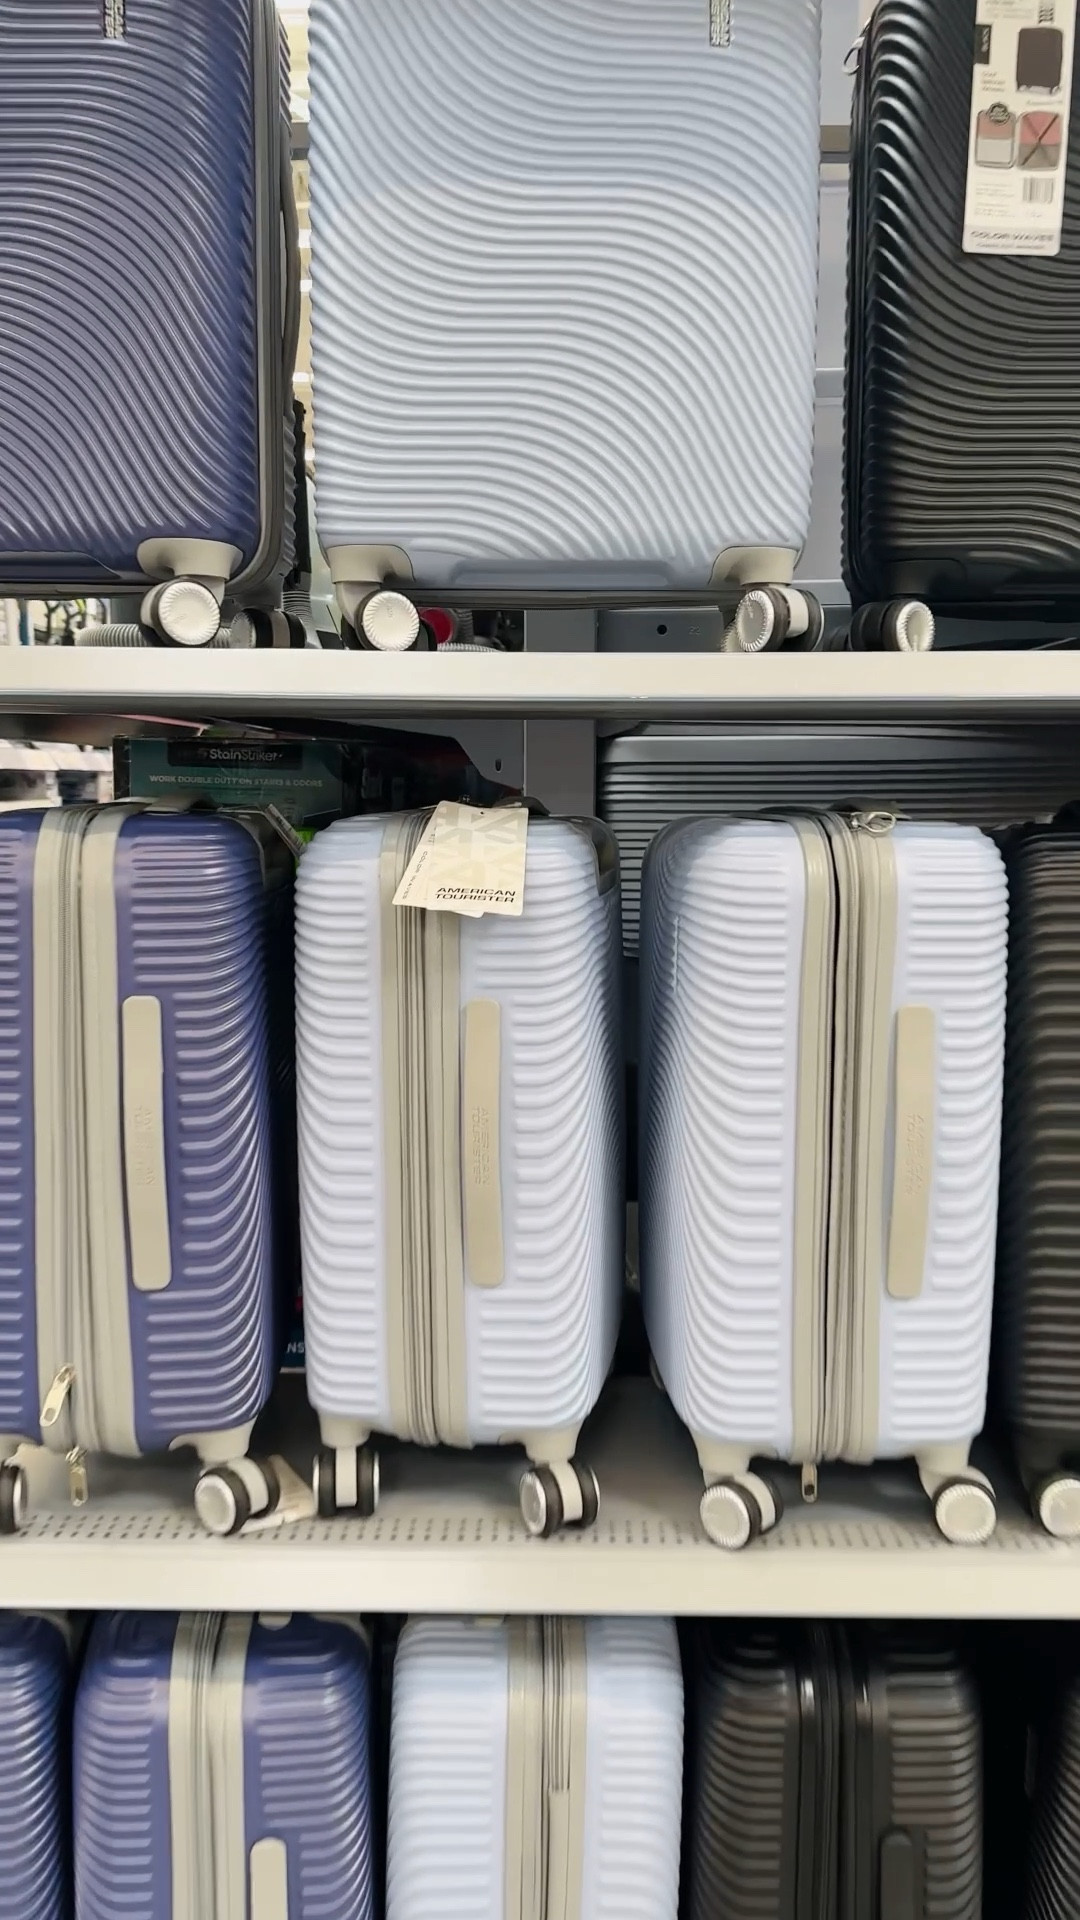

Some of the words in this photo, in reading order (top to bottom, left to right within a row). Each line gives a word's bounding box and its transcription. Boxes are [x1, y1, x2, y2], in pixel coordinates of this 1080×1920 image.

[209, 748, 278, 762] StainStriker
[150, 774, 176, 784] WORK
[178, 775, 213, 785] DOUBLE
[437, 887, 516, 897] AMERICAN
[435, 893, 515, 903] TOURISTER
